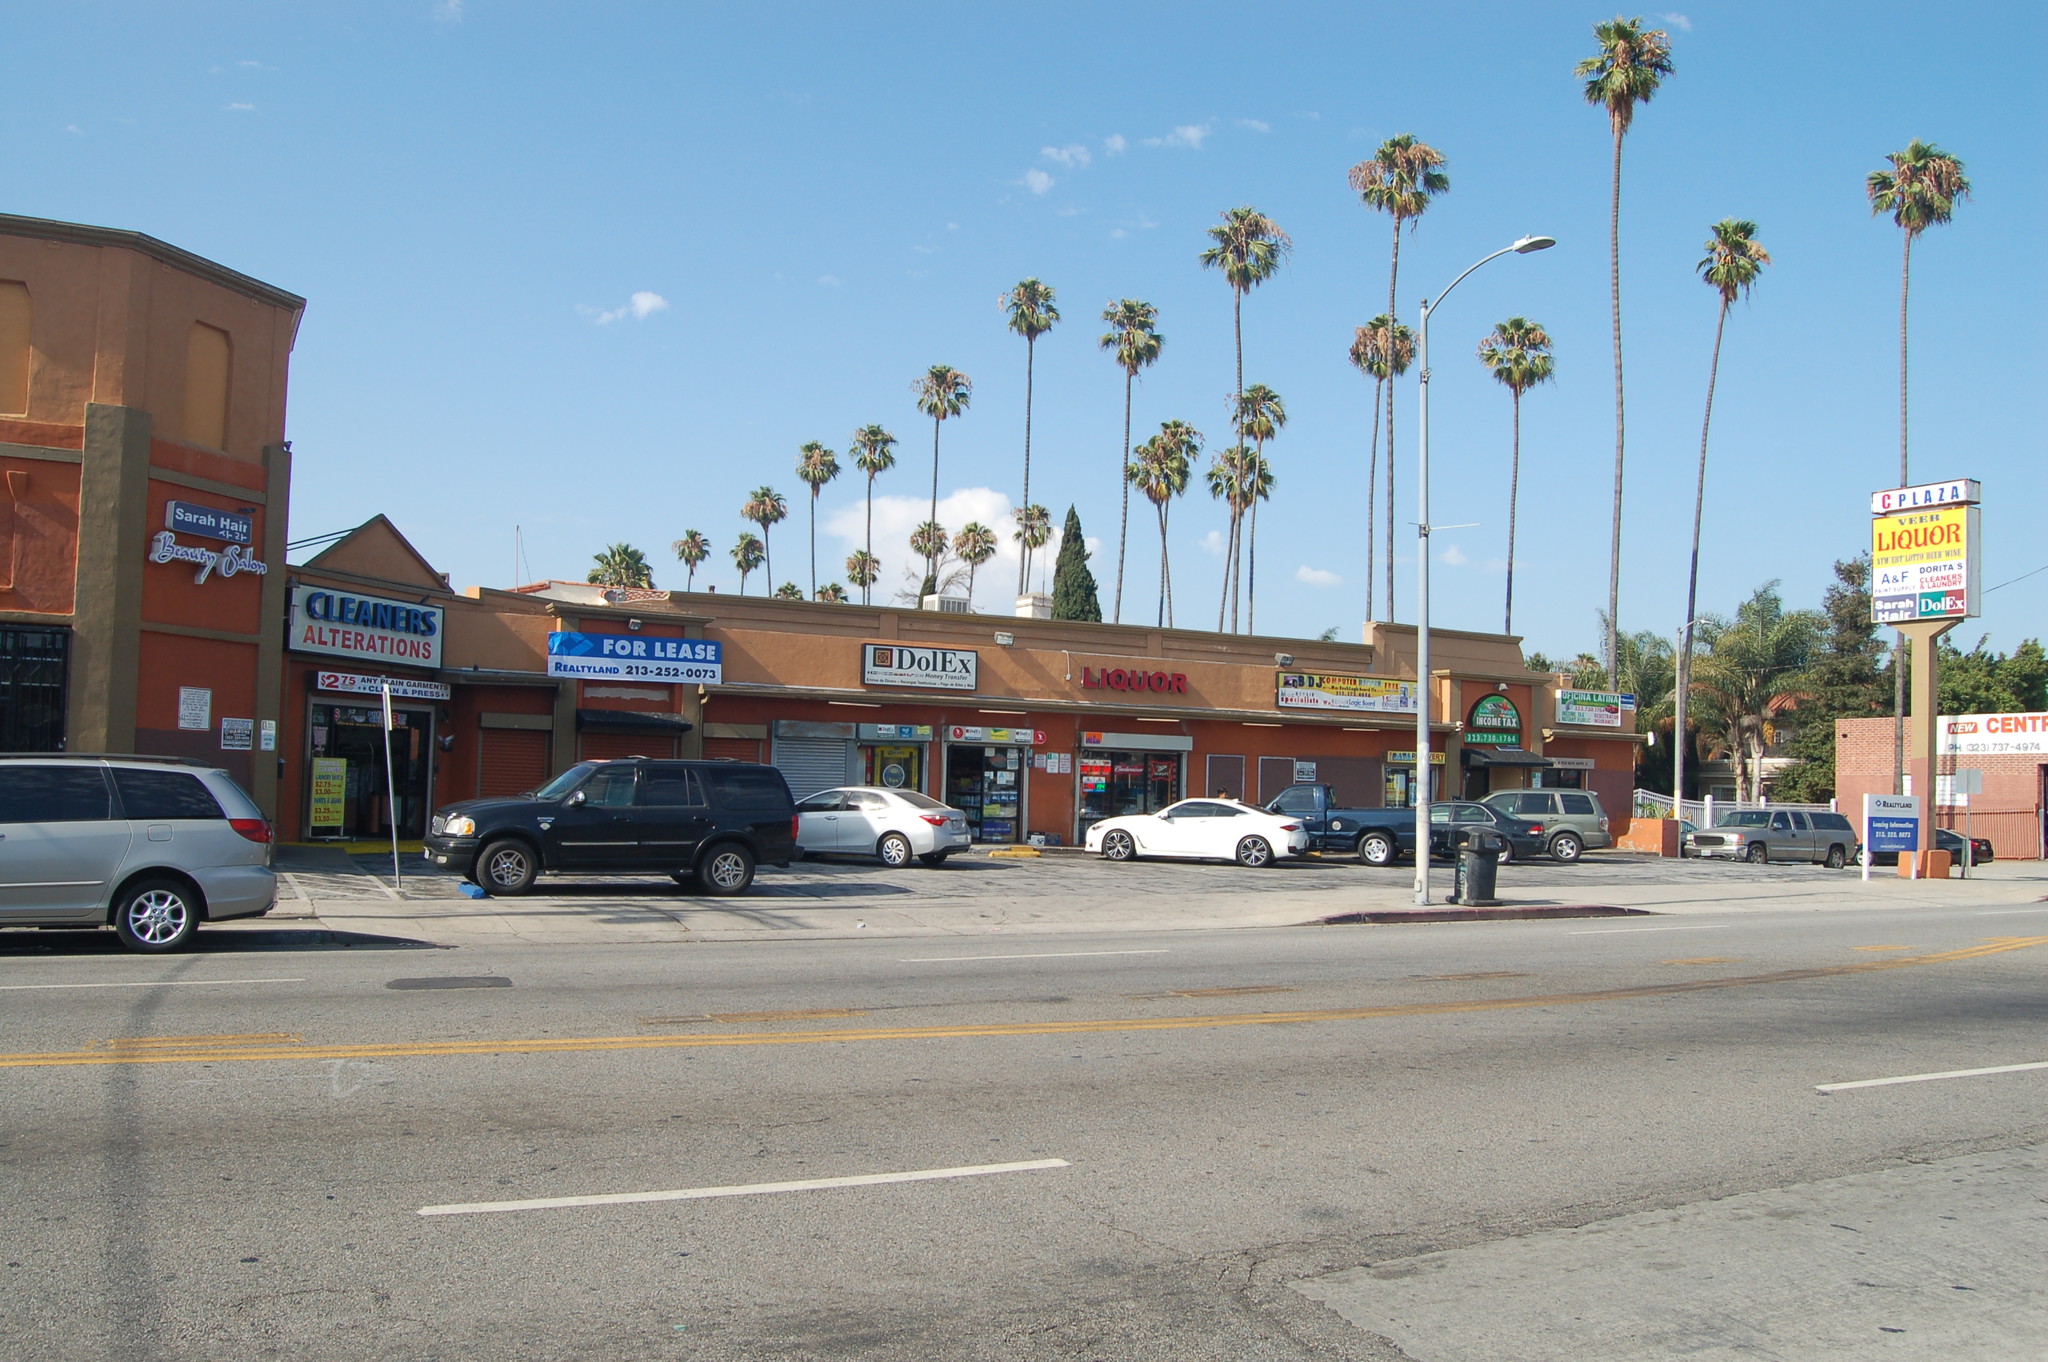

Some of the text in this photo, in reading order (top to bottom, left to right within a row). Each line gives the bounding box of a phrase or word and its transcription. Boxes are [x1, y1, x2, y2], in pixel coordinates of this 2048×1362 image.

[1898, 485, 1960, 508] PLAZA
[174, 507, 248, 533] Sarah Hair
[1898, 514, 1940, 526] VEER
[1877, 523, 1961, 552] LIQUOR
[155, 531, 268, 584] Beauty Salon
[1919, 574, 1962, 584] CLEANERS
[1927, 580, 1962, 589] LAUNDRY
[1874, 599, 1914, 611] Sarah
[1920, 596, 1965, 612] DolEx
[306, 592, 437, 637] CLEANERS
[303, 625, 432, 660] ALTERATIONS
[603, 639, 716, 661] FOR LEASE
[896, 648, 972, 674] DolEx
[625, 665, 717, 679] 213-252-0073
[925, 672, 943, 681] Money
[360, 676, 449, 691] ANY PLAIN GARMENTS
[1081, 667, 1188, 694] LIQUOR
[1322, 676, 1358, 686] COMPUTER
[412, 689, 441, 698] PRESS
[1562, 691, 1591, 701] OFICINA
[1593, 693, 1619, 703] LATINA
[1476, 716, 1502, 726] INCOME
[1502, 718, 1517, 727] TAX
[1949, 723, 1976, 733] NEW
[1467, 733, 1516, 743] 323.730.1764
[1966, 743, 1989, 752] (323)
[1992, 742, 2041, 752] 737-4974
[1392, 752, 1412, 761] DATA
[1872, 821, 1914, 829] Leasing Information
